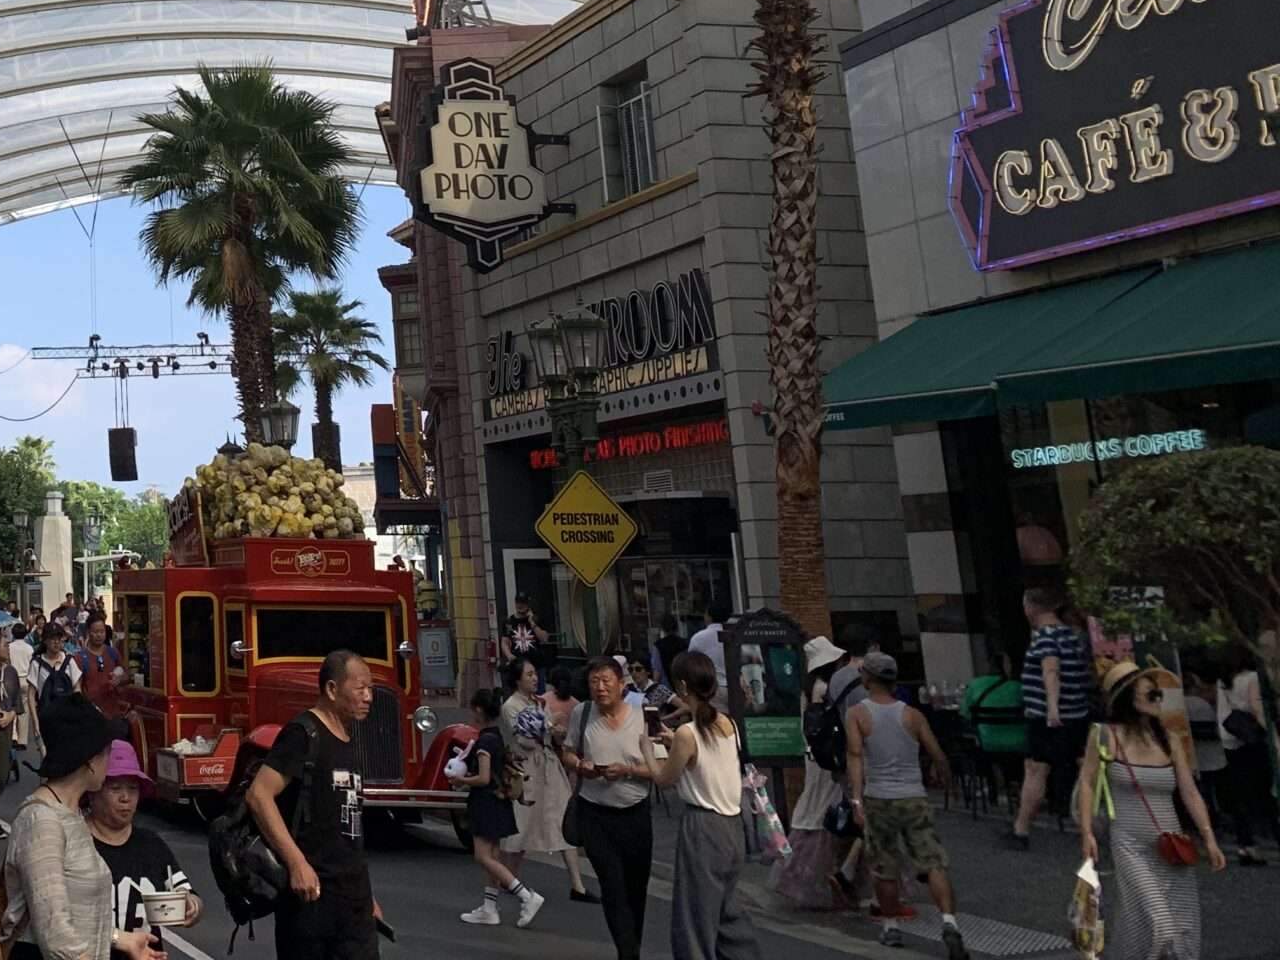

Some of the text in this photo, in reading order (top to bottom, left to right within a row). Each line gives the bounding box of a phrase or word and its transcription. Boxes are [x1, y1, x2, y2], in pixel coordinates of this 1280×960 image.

[448, 112, 511, 139] ONE
[455, 143, 508, 169] DAY
[994, 74, 1174, 215] CAFÉ
[1179, 86, 1239, 163] &
[435, 173, 533, 201] PHOTO
[487, 268, 714, 395] The ROOM
[639, 352, 700, 388] SUPPLIES
[618, 431, 662, 457] PHOTO
[664, 416, 730, 448] FINISHING
[1010, 428, 1207, 469] STARBUCKS COFFEE
[553, 512, 619, 526] PEDESTRIAN
[561, 530, 615, 544] CROSSING
